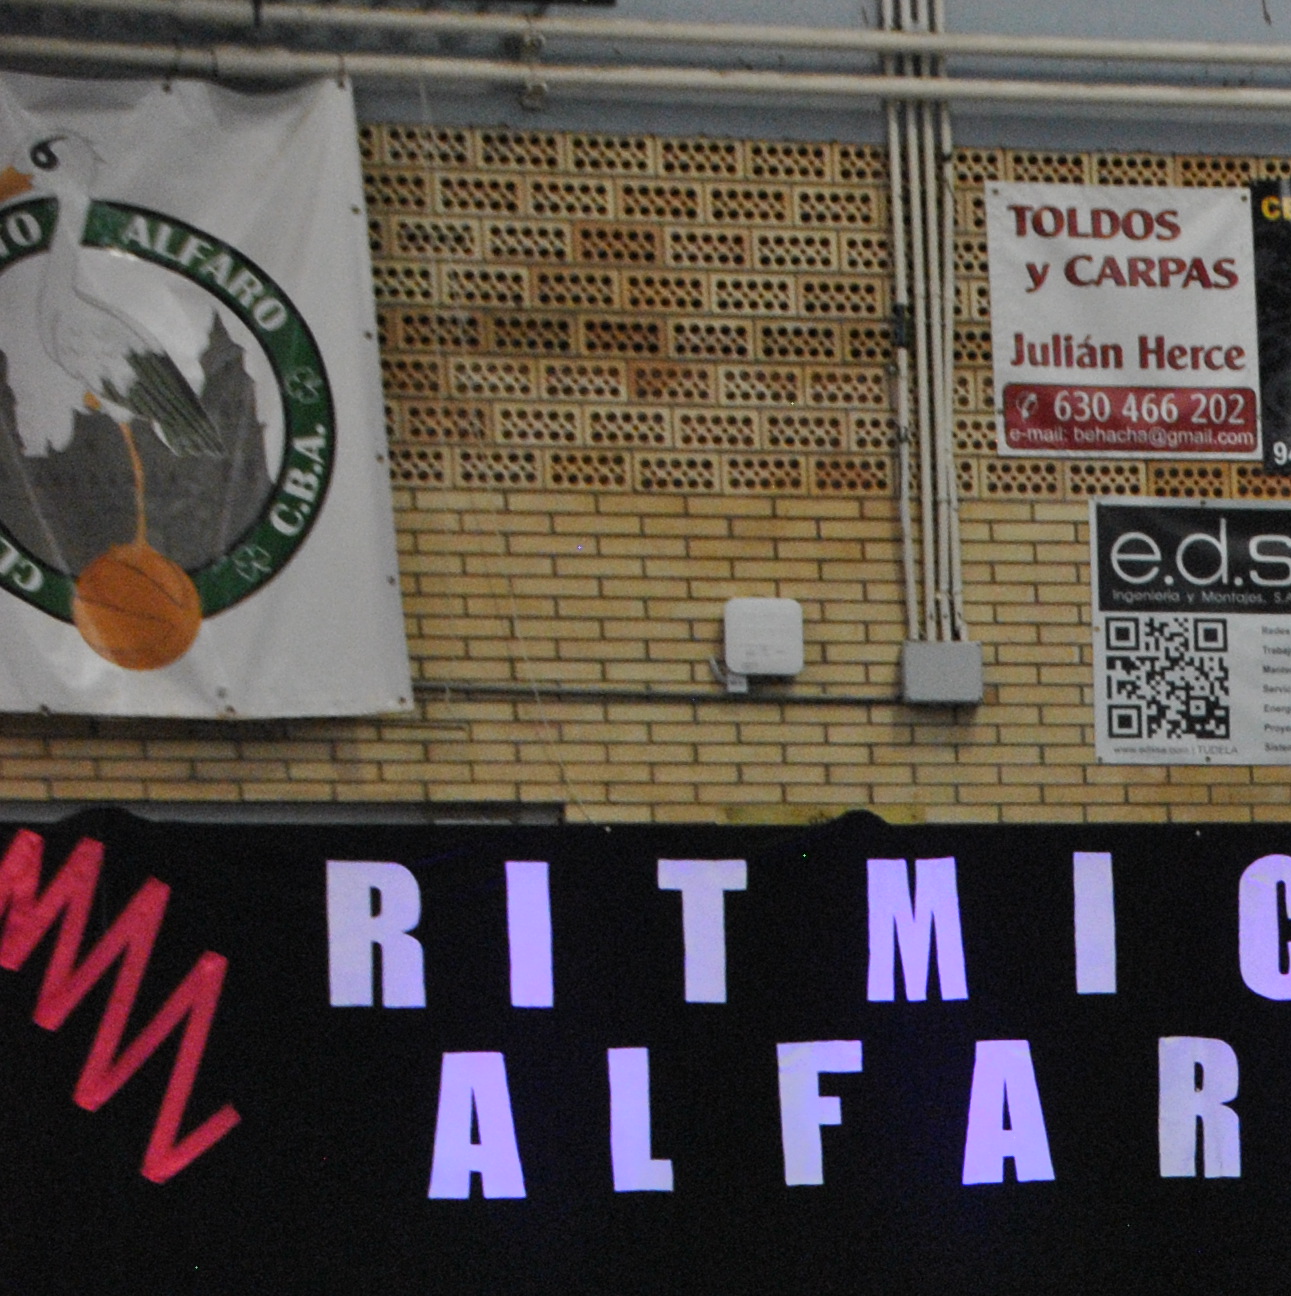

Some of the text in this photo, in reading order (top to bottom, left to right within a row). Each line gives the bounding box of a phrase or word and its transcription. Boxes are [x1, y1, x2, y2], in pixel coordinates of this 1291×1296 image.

[1007, 204, 1181, 240] TOLDOS
[122, 214, 288, 333] ALFARO
[1025, 254, 1239, 293] y CARPAS
[1010, 332, 1246, 371] Julián Herce
[1054, 390, 1246, 425] 630 466 202
[1009, 426, 1067, 443] e-mail:
[269, 423, 327, 538] C.B.A.
